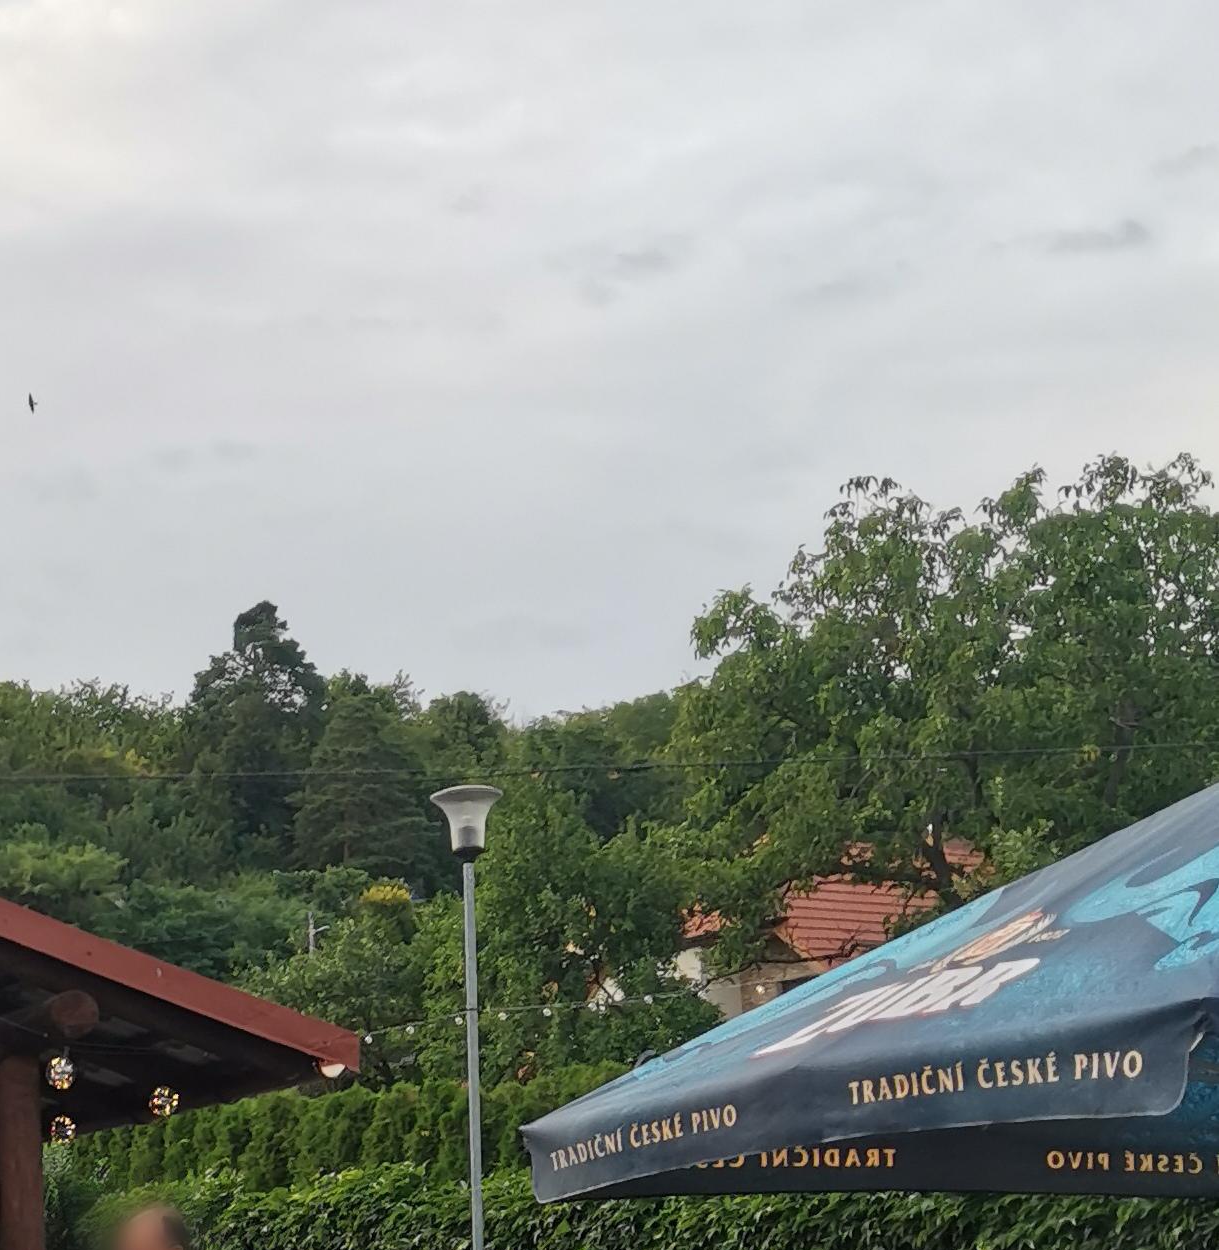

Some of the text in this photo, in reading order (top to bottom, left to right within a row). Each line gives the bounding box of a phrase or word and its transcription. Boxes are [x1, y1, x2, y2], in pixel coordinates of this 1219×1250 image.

[847, 1049, 1144, 1105] TRADIČNÍ ČESKÉ PIVO
[549, 1103, 738, 1171] TRADIČNÍ ČESKÉ PIVO
